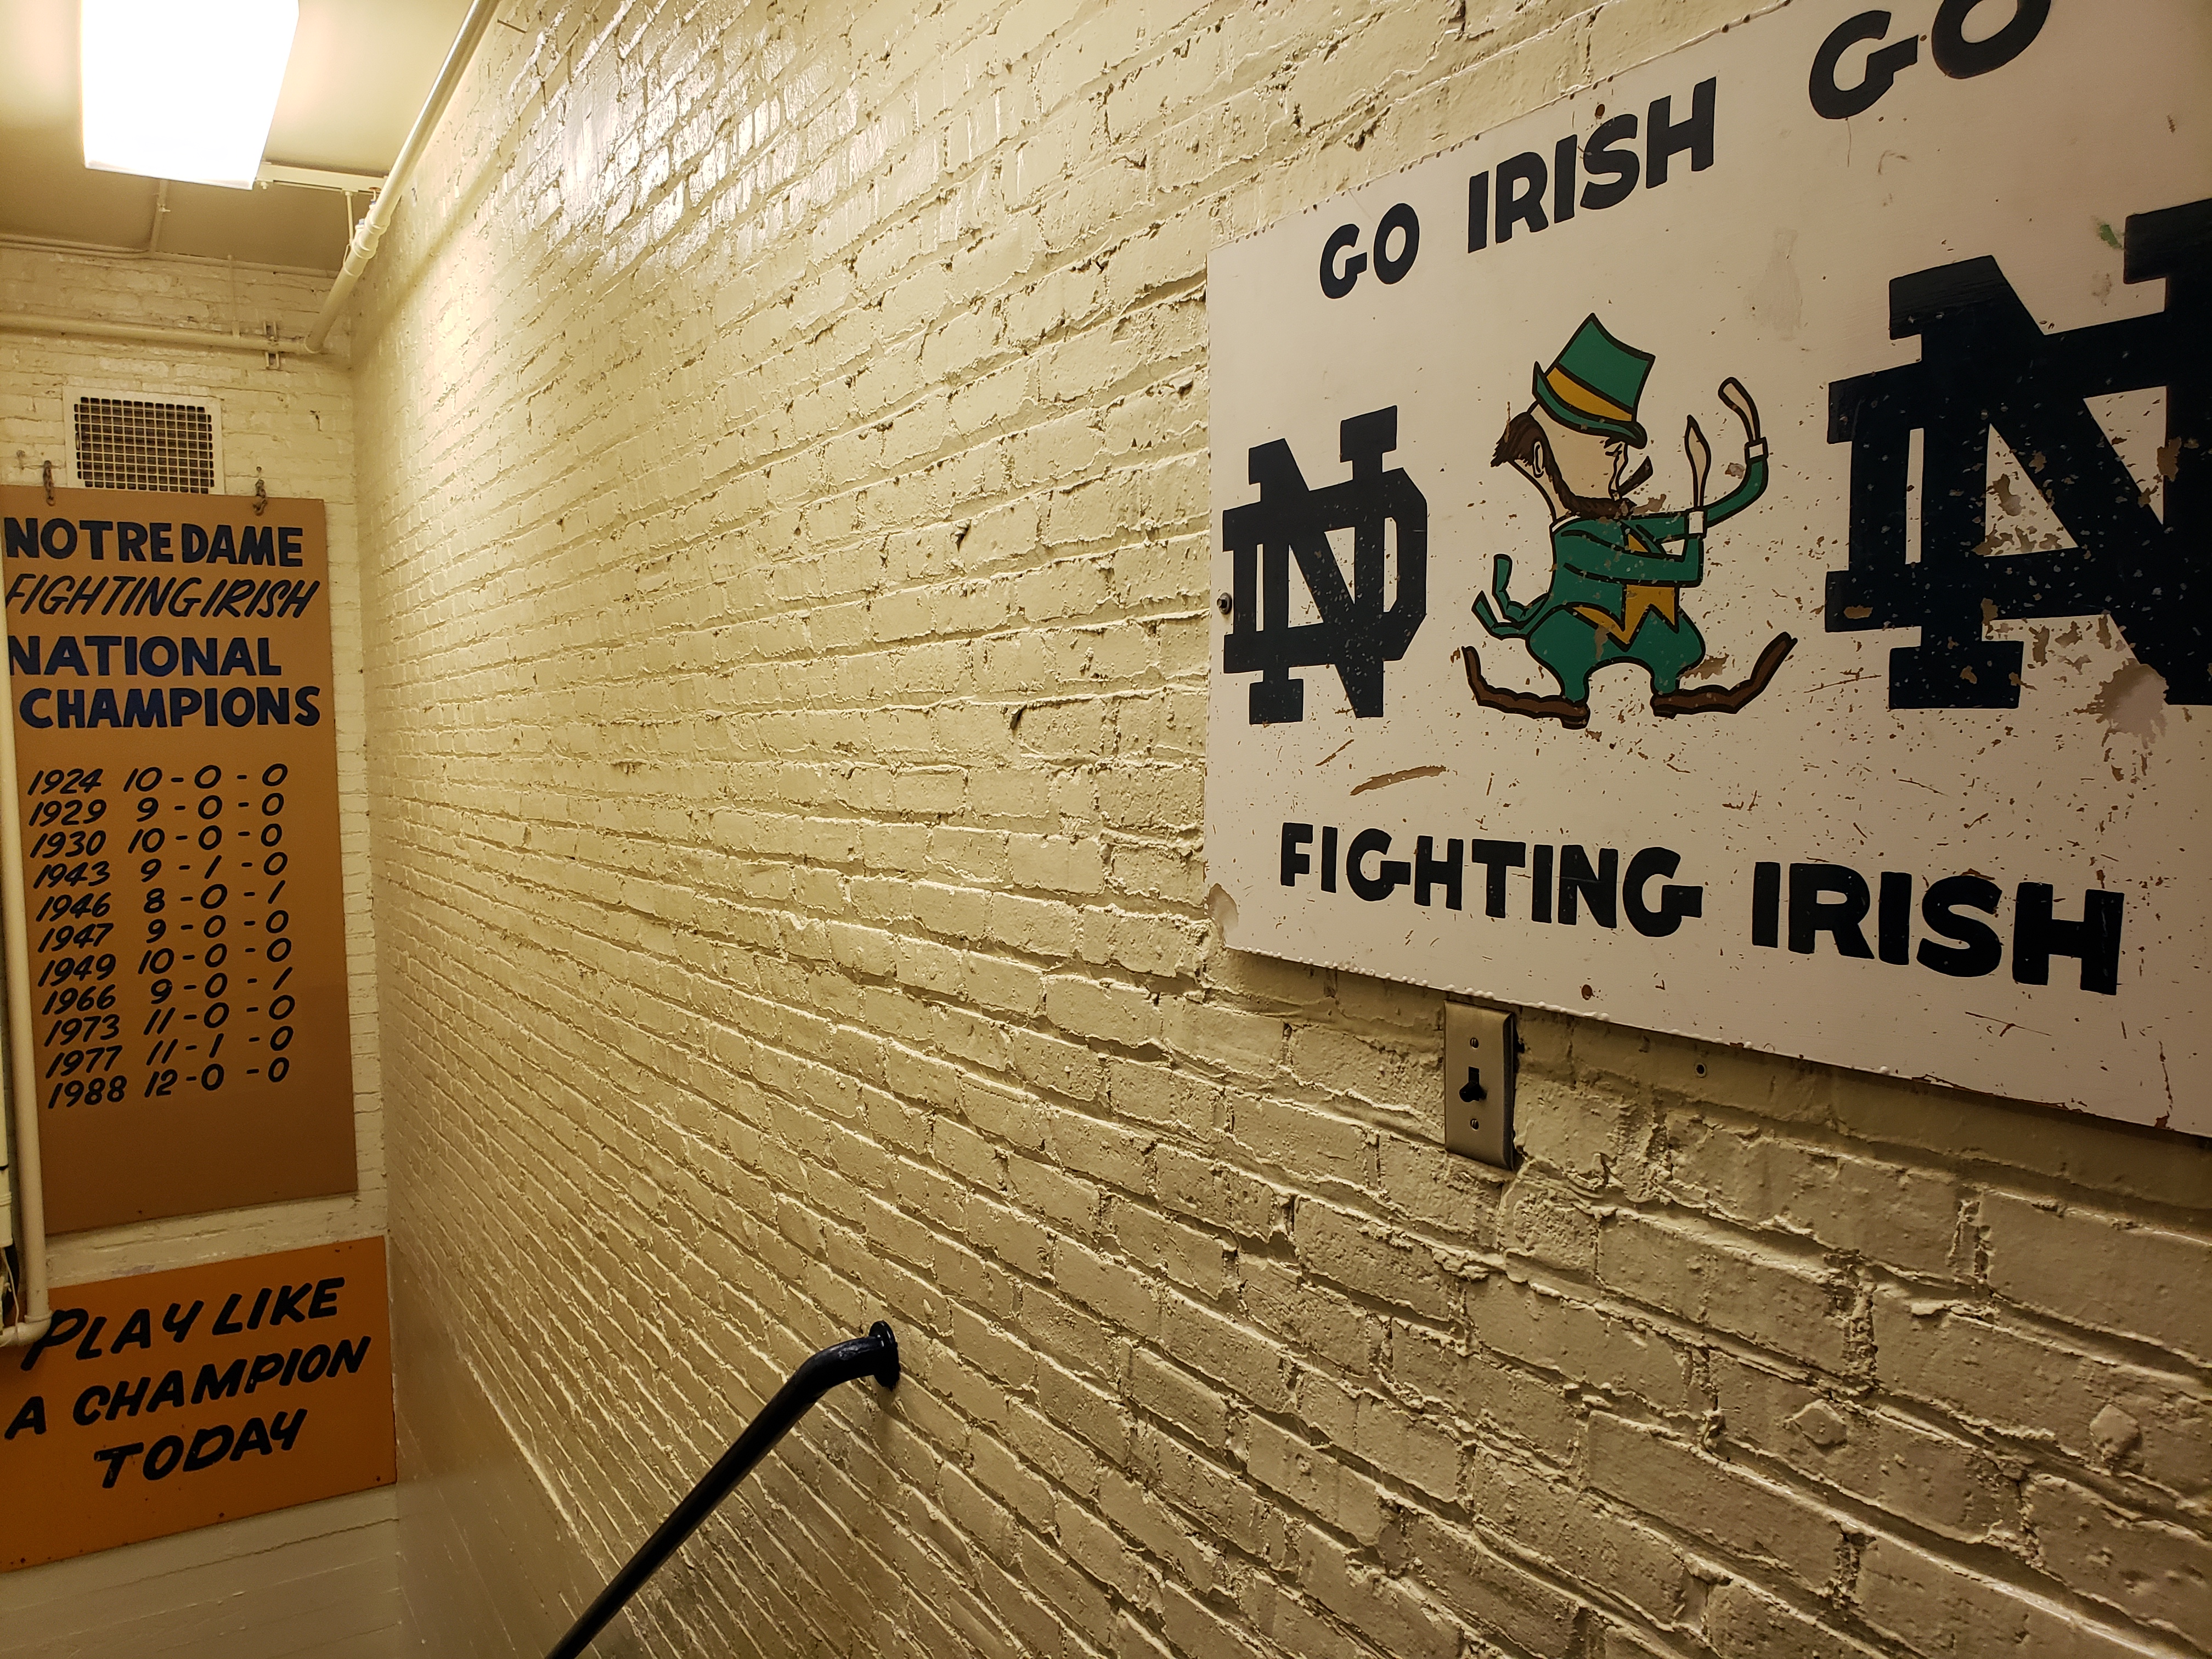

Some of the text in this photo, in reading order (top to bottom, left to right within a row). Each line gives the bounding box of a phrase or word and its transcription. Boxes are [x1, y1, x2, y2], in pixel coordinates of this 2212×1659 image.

[1319, 0, 2051, 299] GO IRISH GO
[3, 517, 303, 567] NOTRE DAME
[5, 573, 320, 618] FIGHTING IRISH
[7, 635, 282, 677] NATIONAL
[19, 686, 321, 729] CHAMPIONS
[27, 768, 103, 796] 1924
[29, 799, 107, 827] 1929
[30, 830, 106, 859] 1930
[33, 860, 110, 889] 1943
[36, 891, 111, 922] 1946
[1280, 822, 2125, 996] FIGHTING IRISH
[37, 923, 114, 953] 1947
[37, 953, 116, 988] 1949
[42, 984, 116, 1015] 1966
[44, 1014, 120, 1047] 1973
[45, 1045, 123, 1079] 1977
[48, 1075, 127, 1109] 1988
[20, 1277, 345, 1372] PLAY LIKE
[4, 1336, 371, 1440] A CHAMPION
[94, 1408, 308, 1488] TODAY
